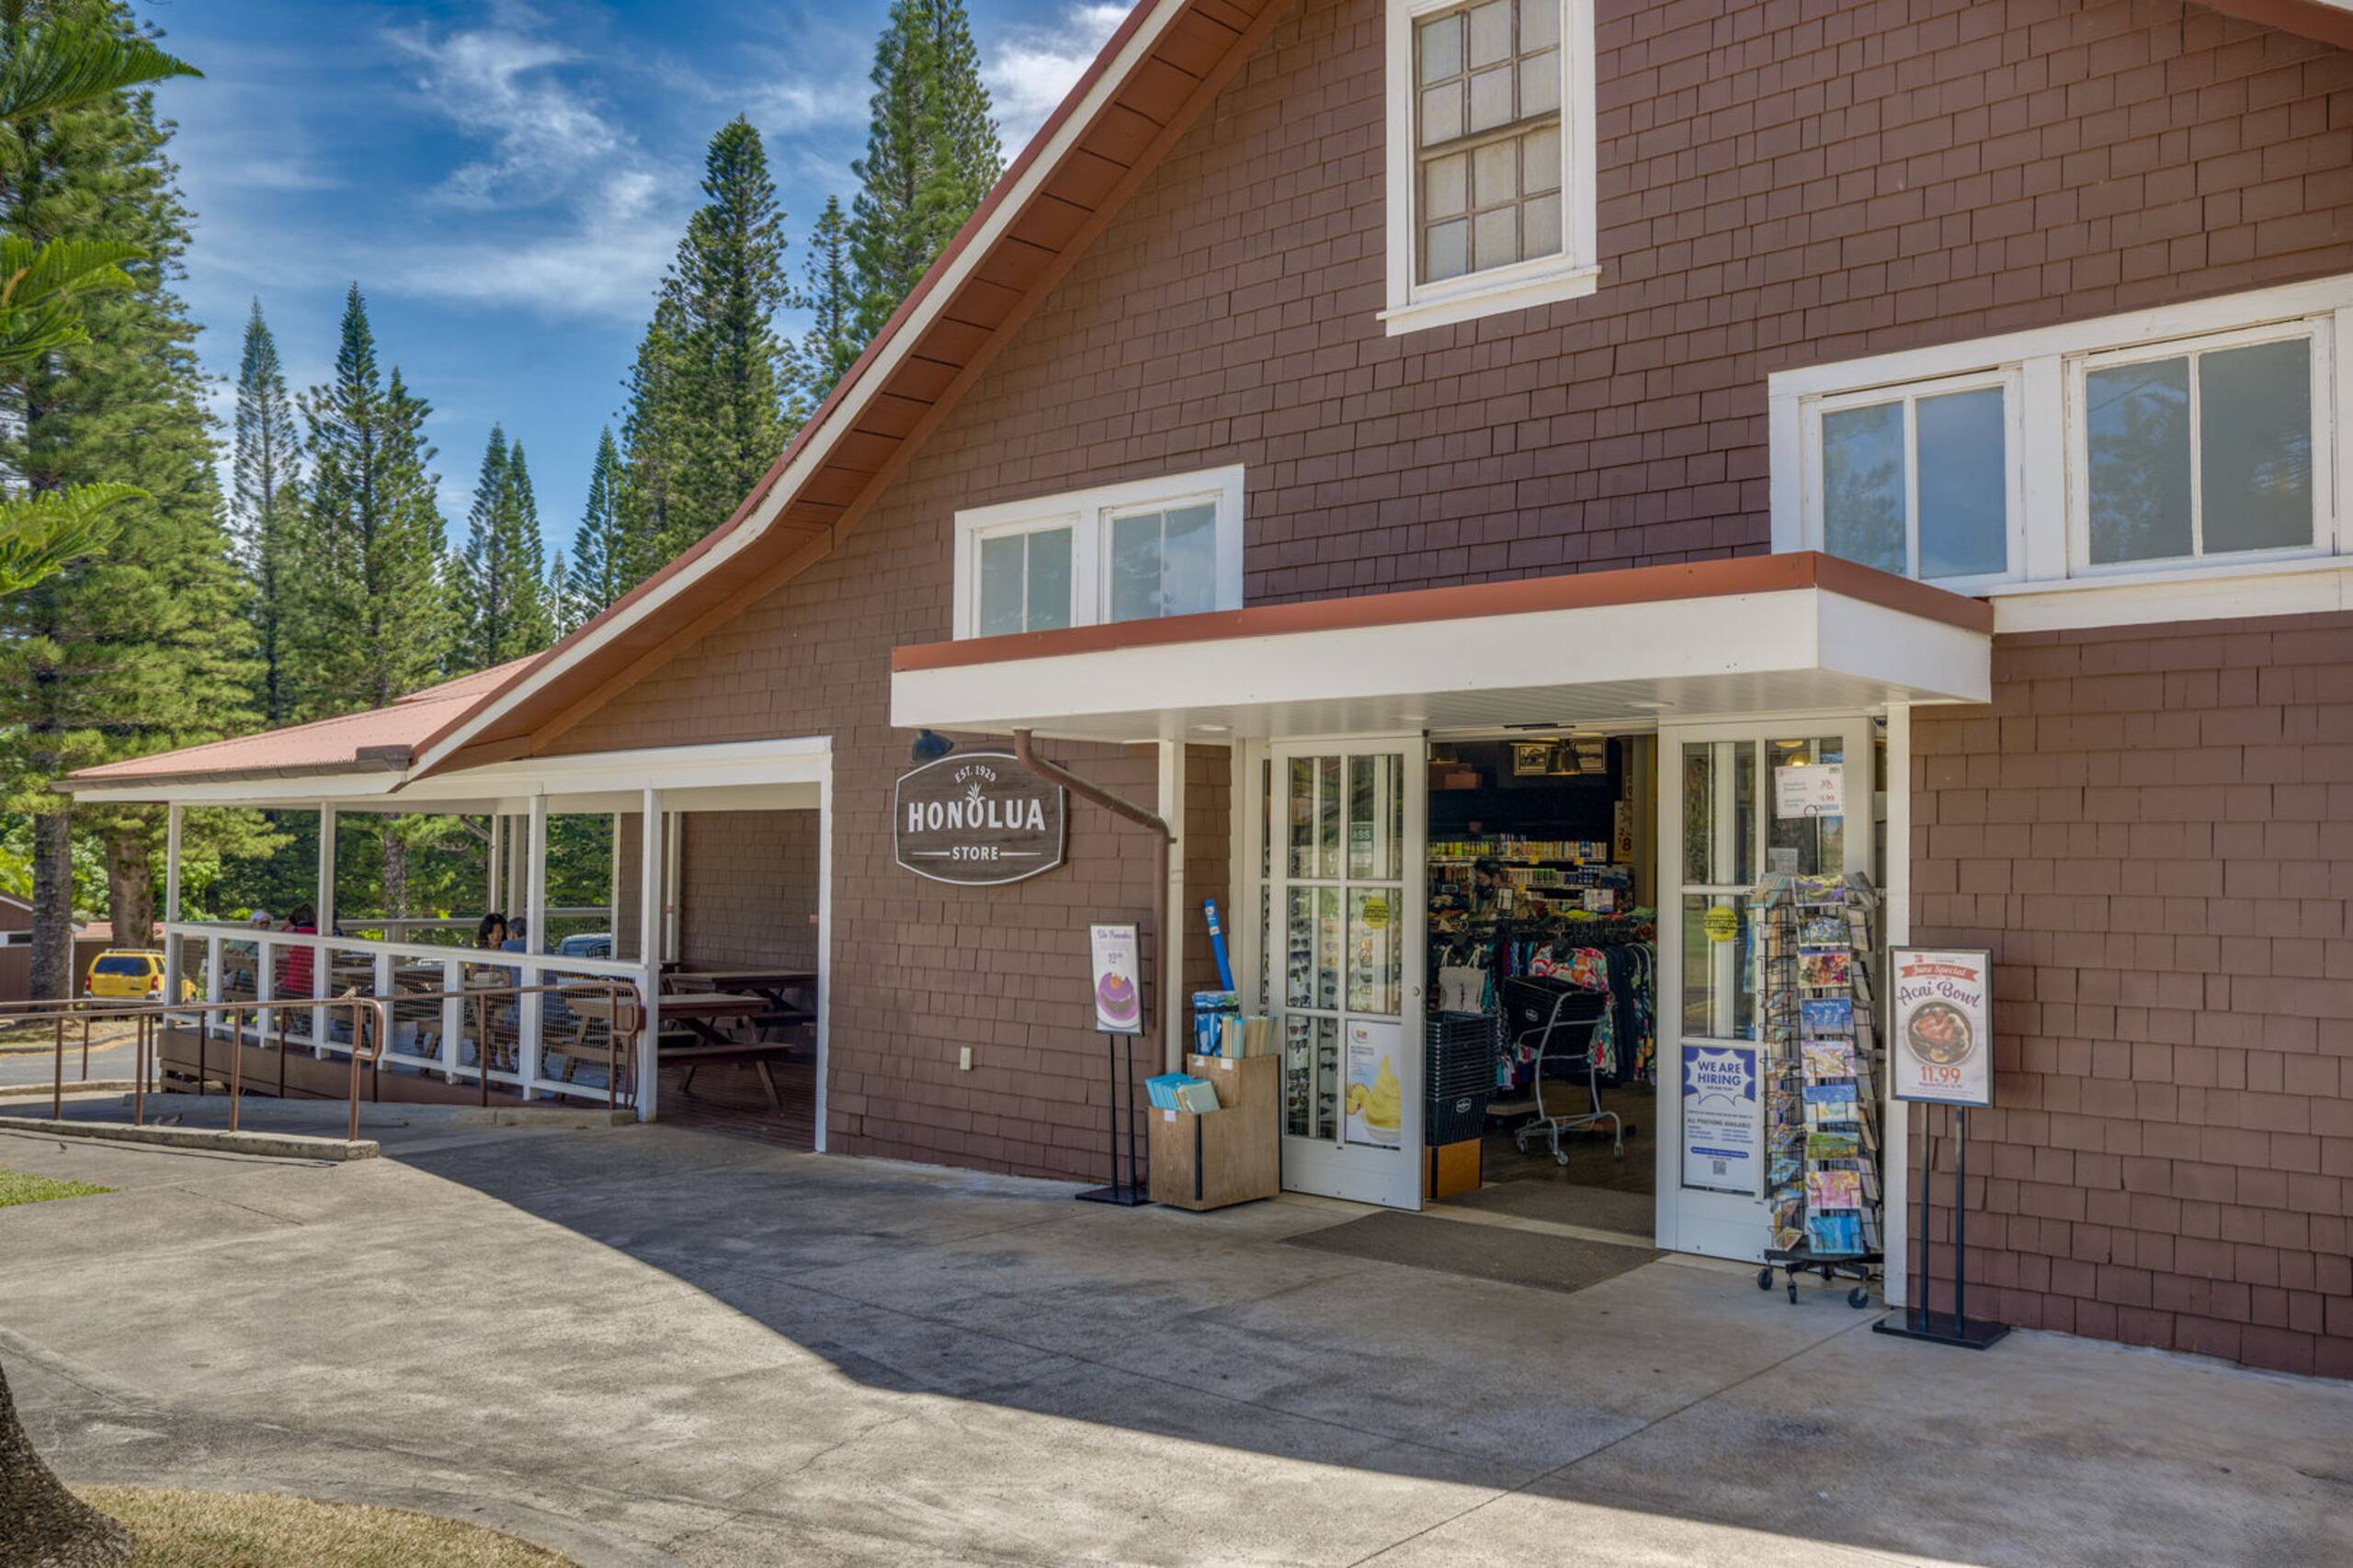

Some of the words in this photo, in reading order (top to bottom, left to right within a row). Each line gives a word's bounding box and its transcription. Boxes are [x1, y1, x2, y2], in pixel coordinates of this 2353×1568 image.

[955, 765, 972, 783] EST.
[975, 765, 996, 781] 1929
[908, 798, 1046, 833] HONOLUA
[952, 846, 999, 860] STORE
[1898, 981, 1934, 1006] Acai
[1937, 981, 1981, 1007] Bowl
[1698, 1061, 1716, 1073] WE
[1719, 1062, 1741, 1074] ARE
[1921, 1065, 1961, 1084] 11.99
[1698, 1073, 1741, 1086] HIRING
